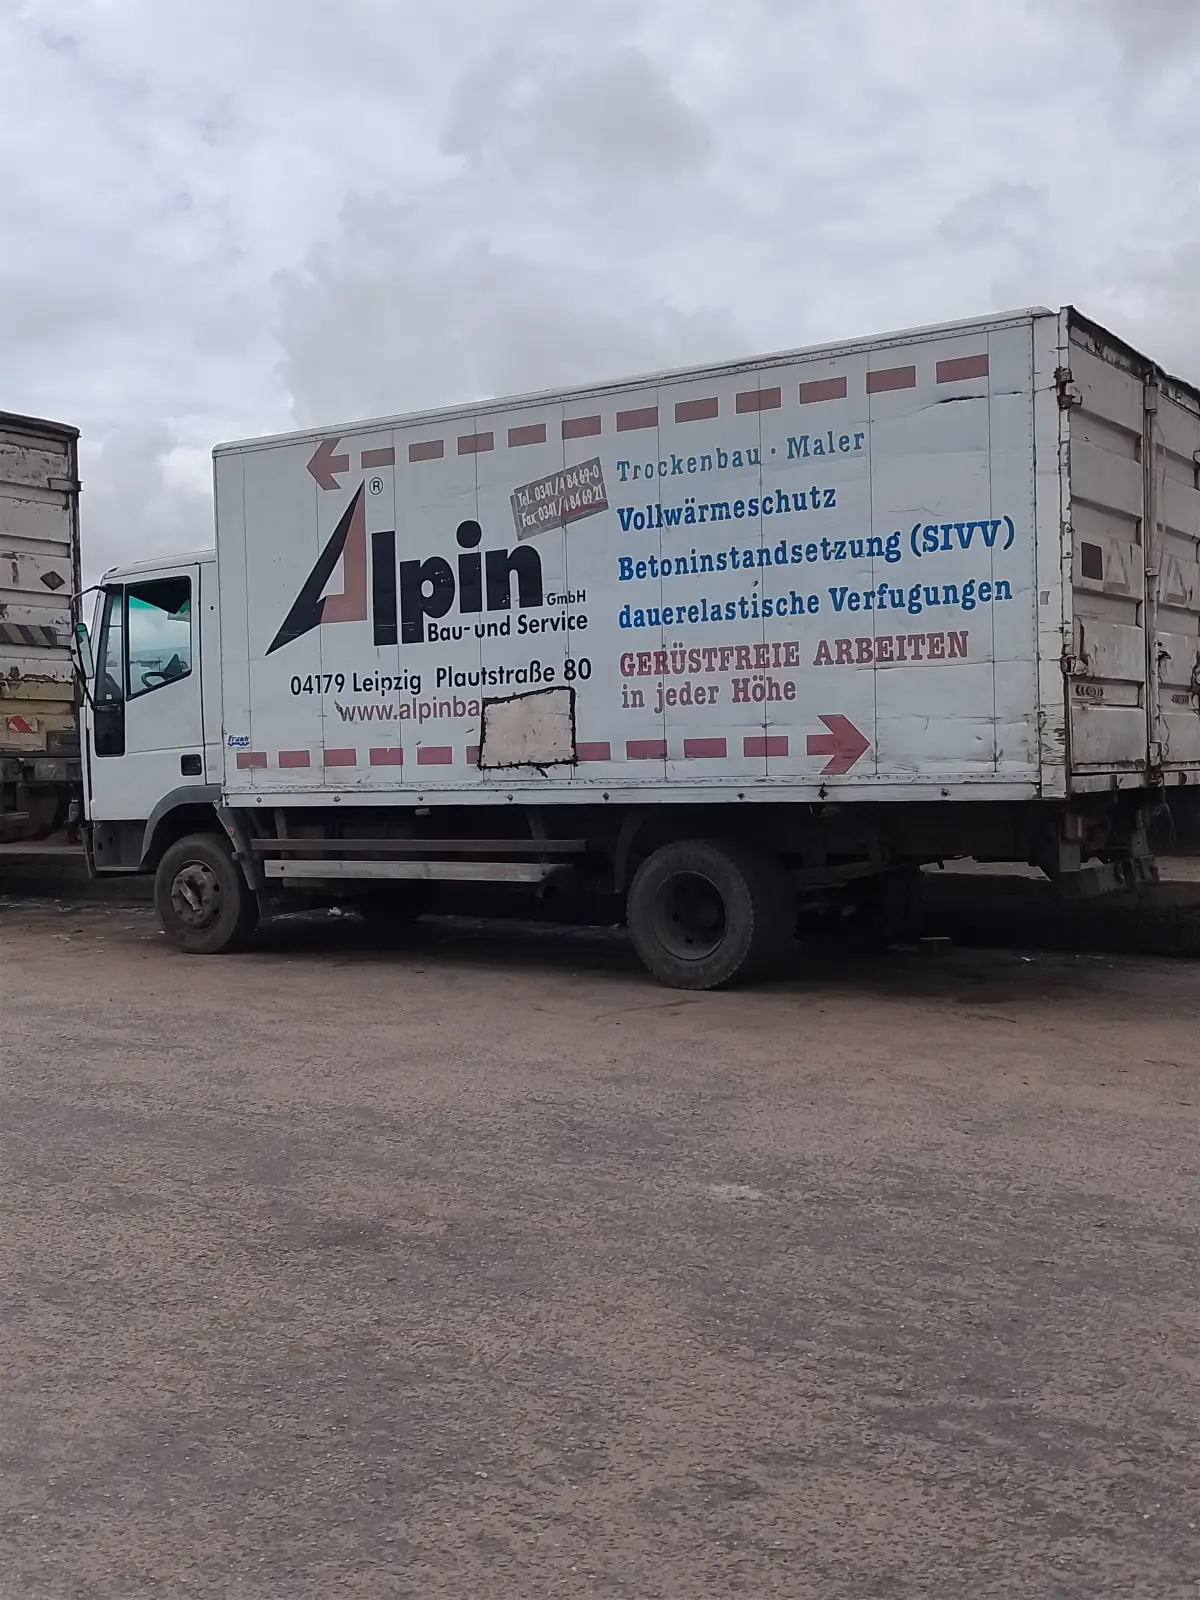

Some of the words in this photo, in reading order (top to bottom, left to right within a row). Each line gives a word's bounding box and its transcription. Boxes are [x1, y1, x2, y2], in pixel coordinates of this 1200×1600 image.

[617, 448, 761, 482] Trockenbau
[786, 431, 865, 460] Maler
[517, 488, 533, 507] Tel.
[617, 486, 837, 532] Vollwärmeschutz
[521, 512, 537, 528] Fax
[265, 478, 544, 657] Alpin
[618, 531, 901, 581] Betoninstandsetzung
[910, 515, 1015, 557] (SIVV)
[546, 589, 586, 606] GmbH
[619, 591, 820, 629] dauerelastische
[828, 579, 1013, 615] Verfugungen
[427, 622, 471, 643] Bau-
[474, 615, 511, 639] und
[517, 610, 589, 635] Service
[620, 641, 800, 677] GERÜSTFREIE
[813, 630, 969, 666] ARBEITEN
[290, 673, 345, 696] 04179
[353, 670, 422, 697] Leipzig
[436, 660, 556, 688] Plautstraße
[563, 658, 592, 681] 80
[621, 683, 645, 709] in
[653, 681, 719, 714] jeder
[731, 674, 796, 704] Höhe
[338, 695, 482, 724] www.alpinba
